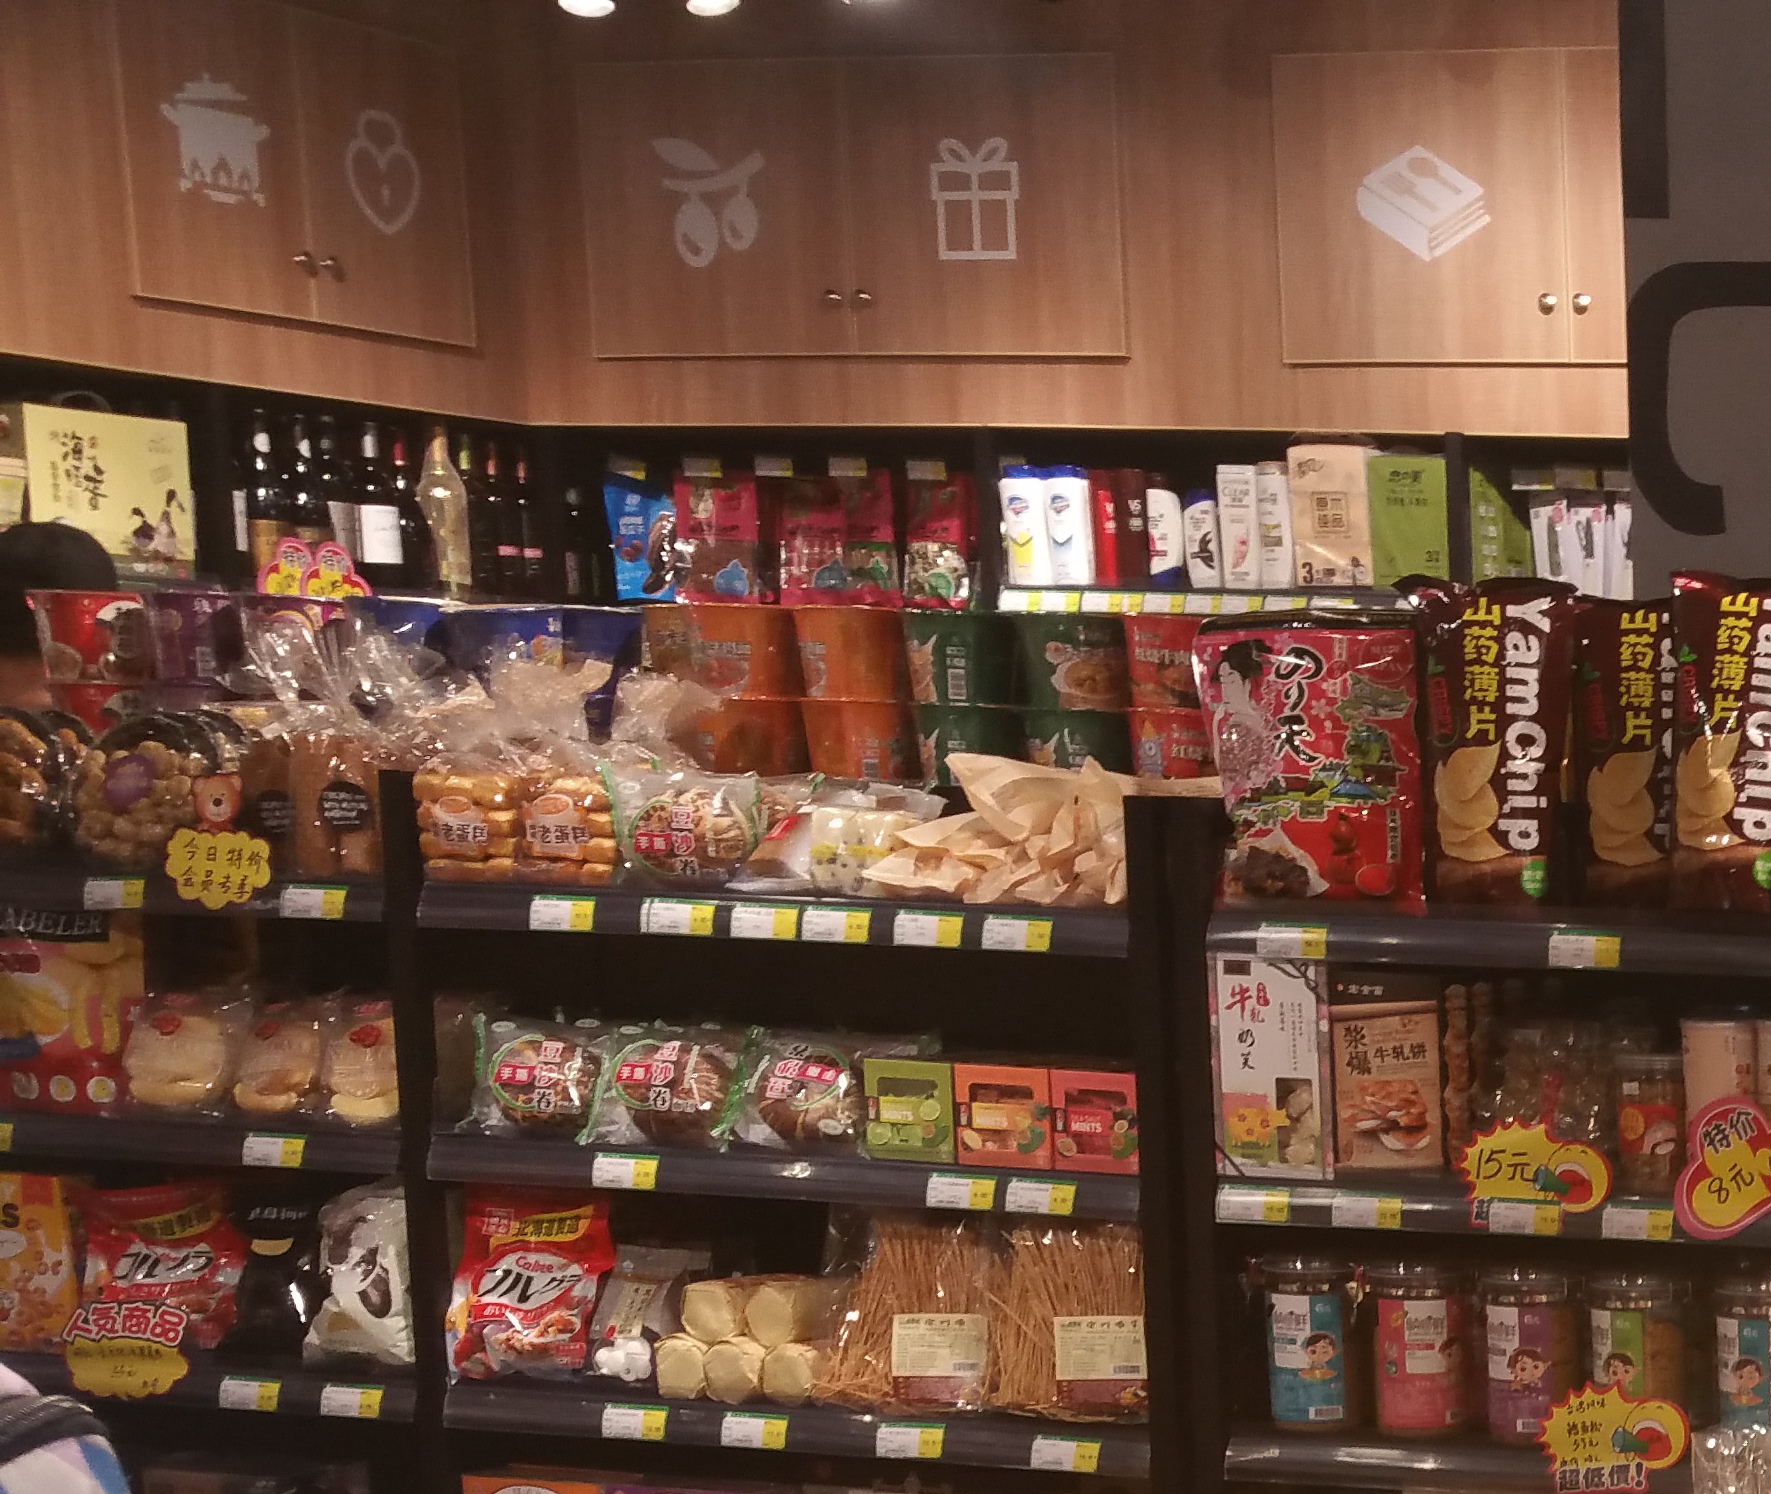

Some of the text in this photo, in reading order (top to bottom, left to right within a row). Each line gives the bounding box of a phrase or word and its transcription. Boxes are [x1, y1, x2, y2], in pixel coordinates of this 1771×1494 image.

[1463, 596, 1501, 741] 山药薄片
[1497, 596, 1551, 851] YamChip
[1620, 609, 1657, 746] 山药薄片
[1711, 592, 1760, 729] 山药薄片
[1701, 1110, 1756, 1153] 特价
[1707, 1162, 1756, 1205] 8元
